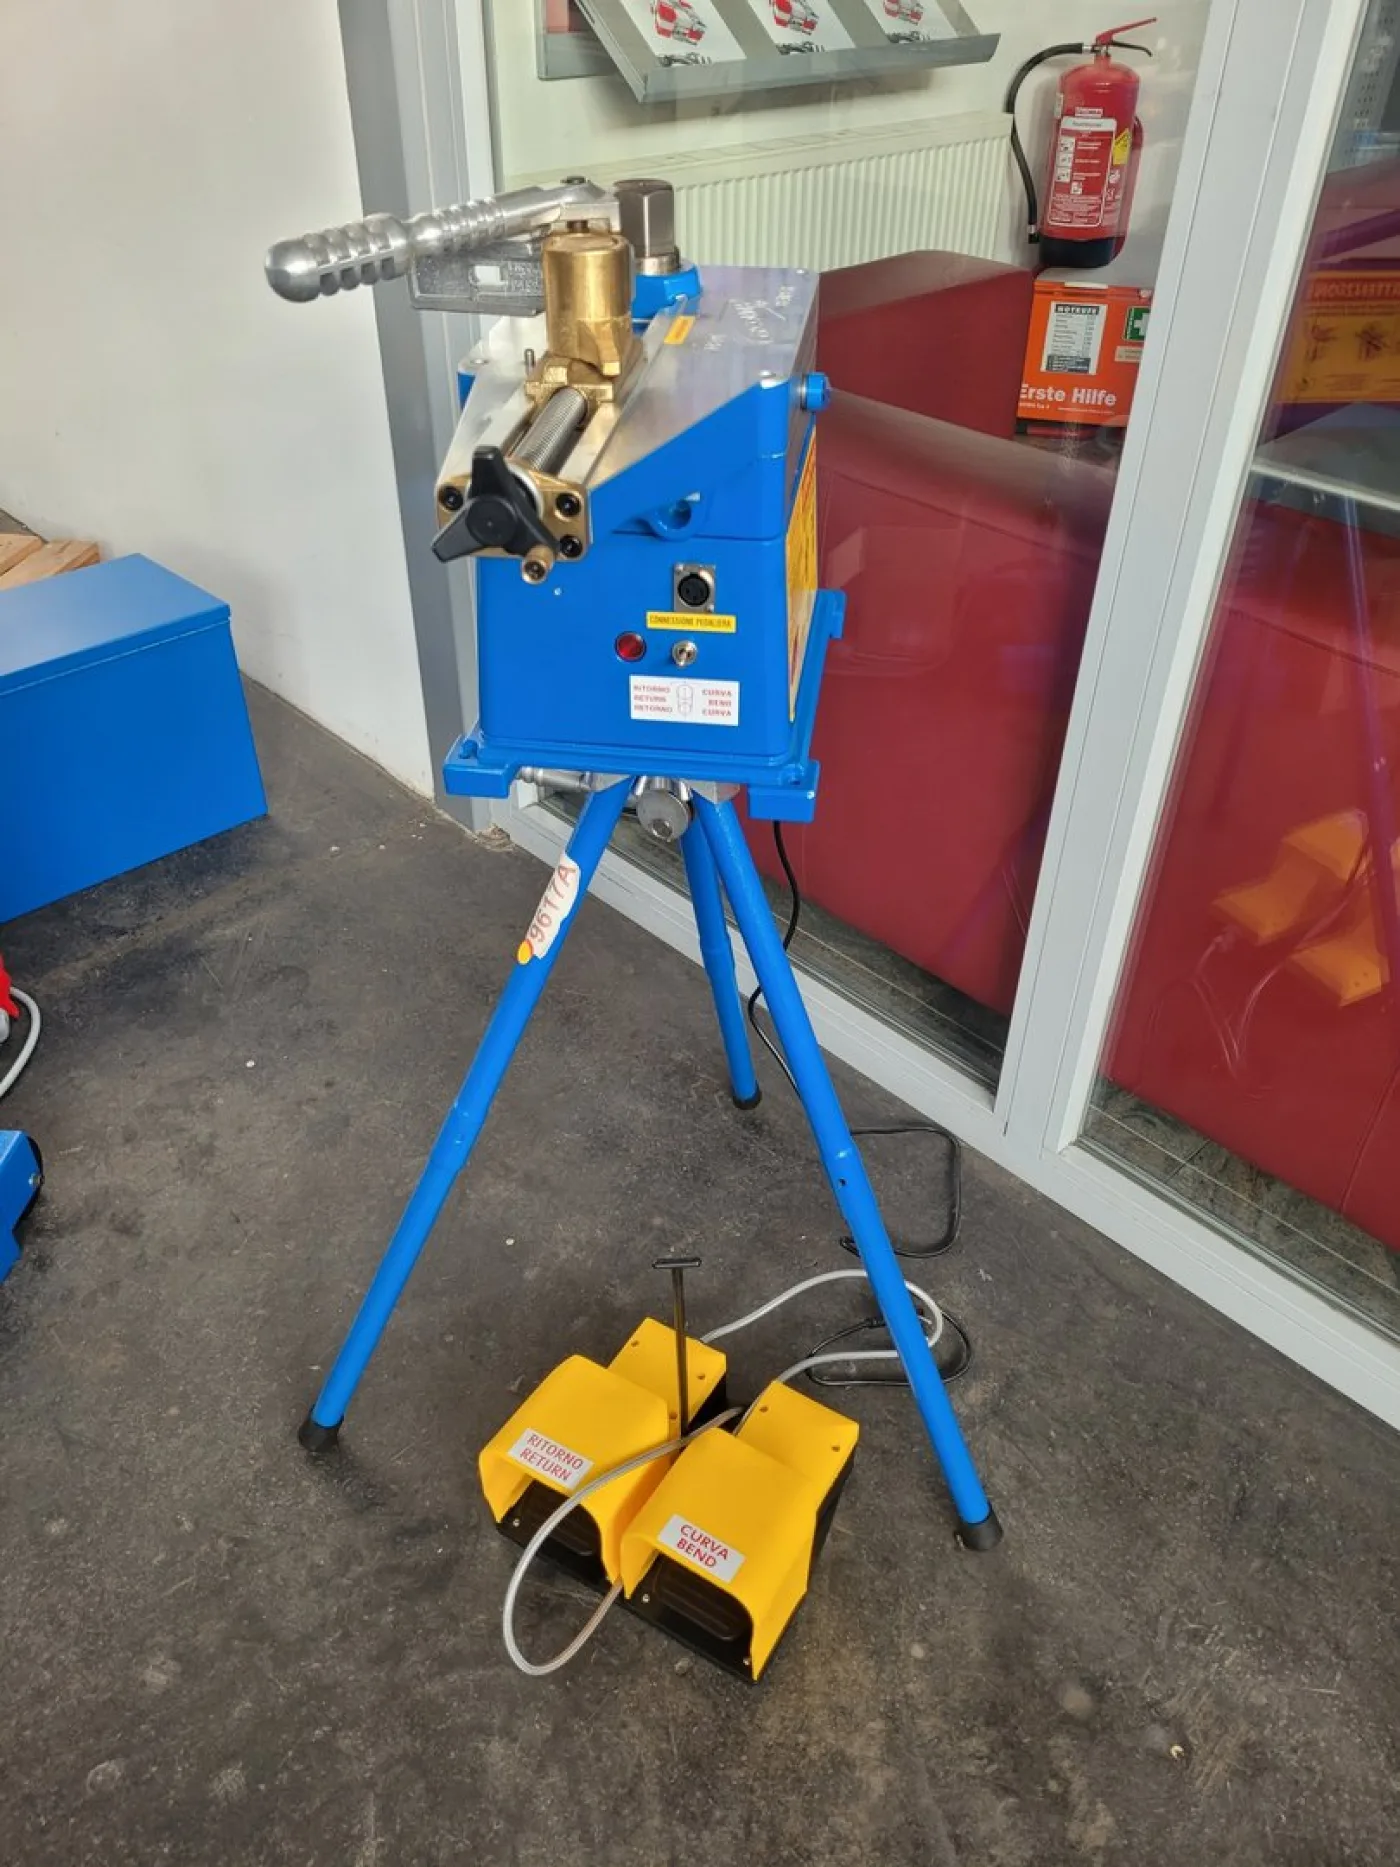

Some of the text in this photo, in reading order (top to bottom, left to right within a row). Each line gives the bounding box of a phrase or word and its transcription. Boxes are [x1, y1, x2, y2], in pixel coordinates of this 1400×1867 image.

[1020, 383, 1117, 406] Erste Hilfe
[633, 683, 671, 694] RITORNO
[702, 688, 732, 698] CURVA
[702, 709, 732, 718] CURVA
[520, 1448, 572, 1481] RETURN
[526, 1433, 584, 1471] RITORNO
[676, 1539, 717, 1568] BEND
[680, 1524, 730, 1561] CURVA
